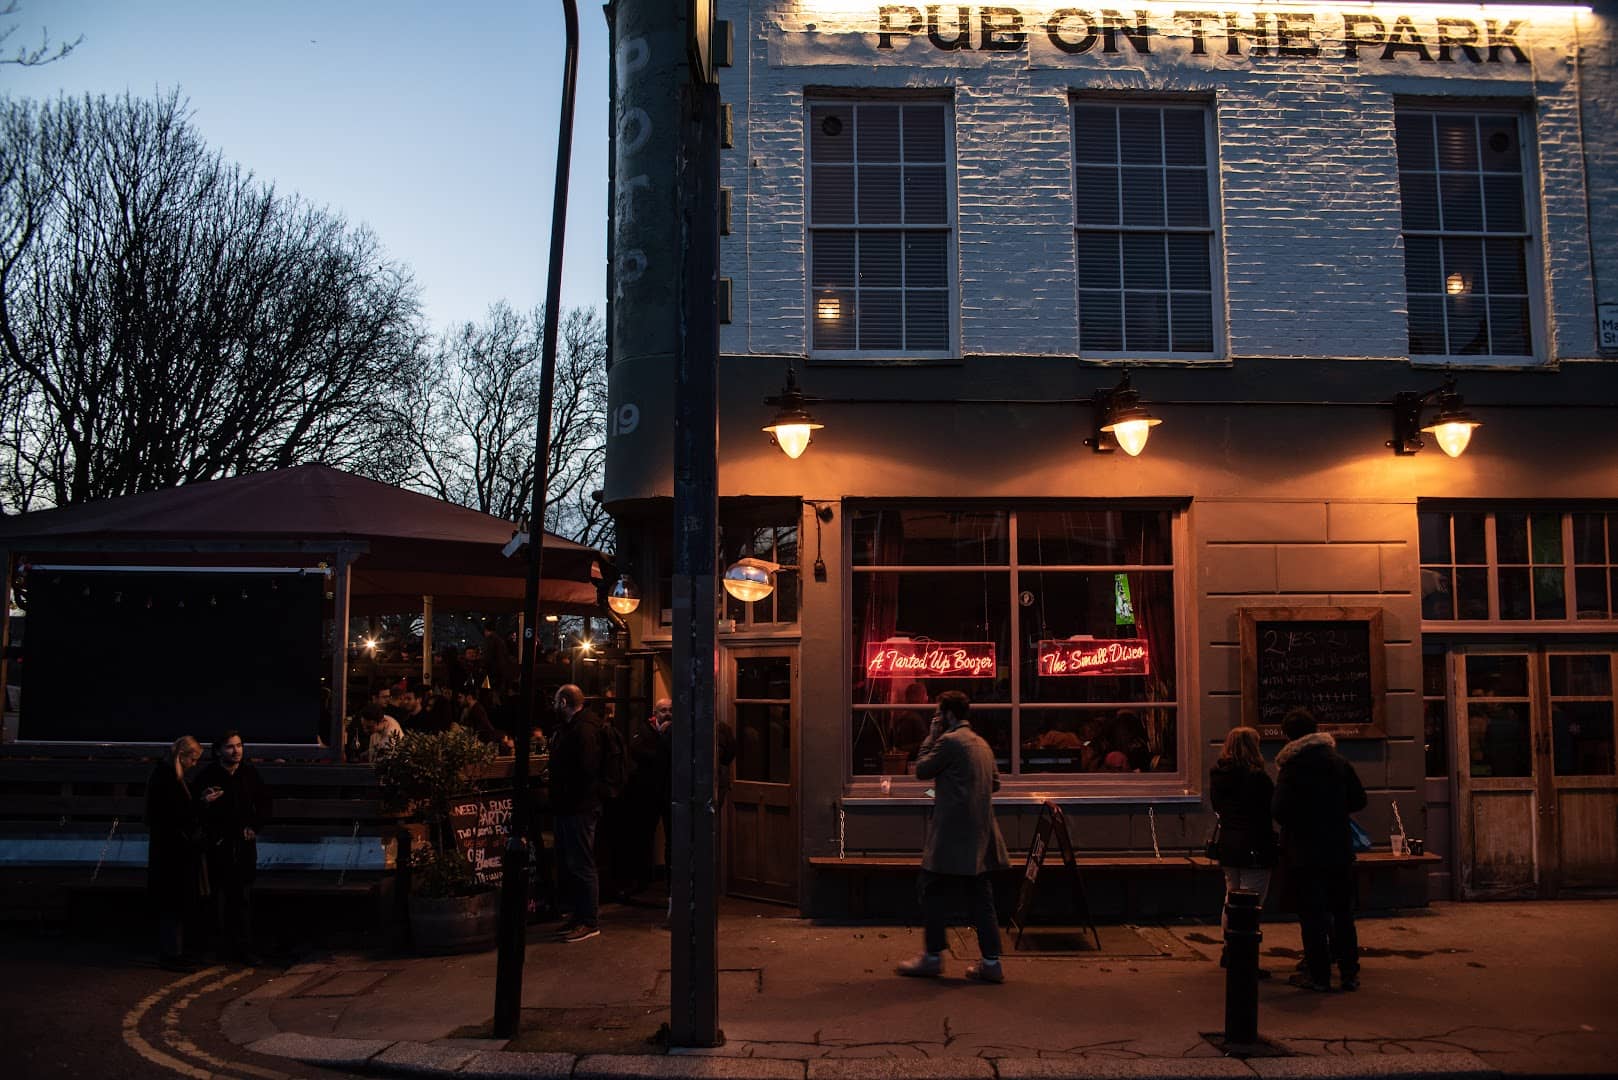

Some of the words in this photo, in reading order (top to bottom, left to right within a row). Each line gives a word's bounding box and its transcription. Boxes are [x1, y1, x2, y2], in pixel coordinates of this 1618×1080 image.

[877, 6, 1027, 51] PUB
[1048, 7, 1154, 54] ON
[1173, 10, 1320, 58] THE
[1341, 13, 1533, 64] PARK
[611, 402, 641, 437] 19
[868, 650, 885, 670] A
[886, 650, 927, 671] Tarted
[929, 650, 951, 674] Up
[953, 649, 993, 675] Boozer
[1043, 652, 1066, 674] The
[1071, 648, 1108, 670] Small
[1109, 643, 1145, 662] Disco
